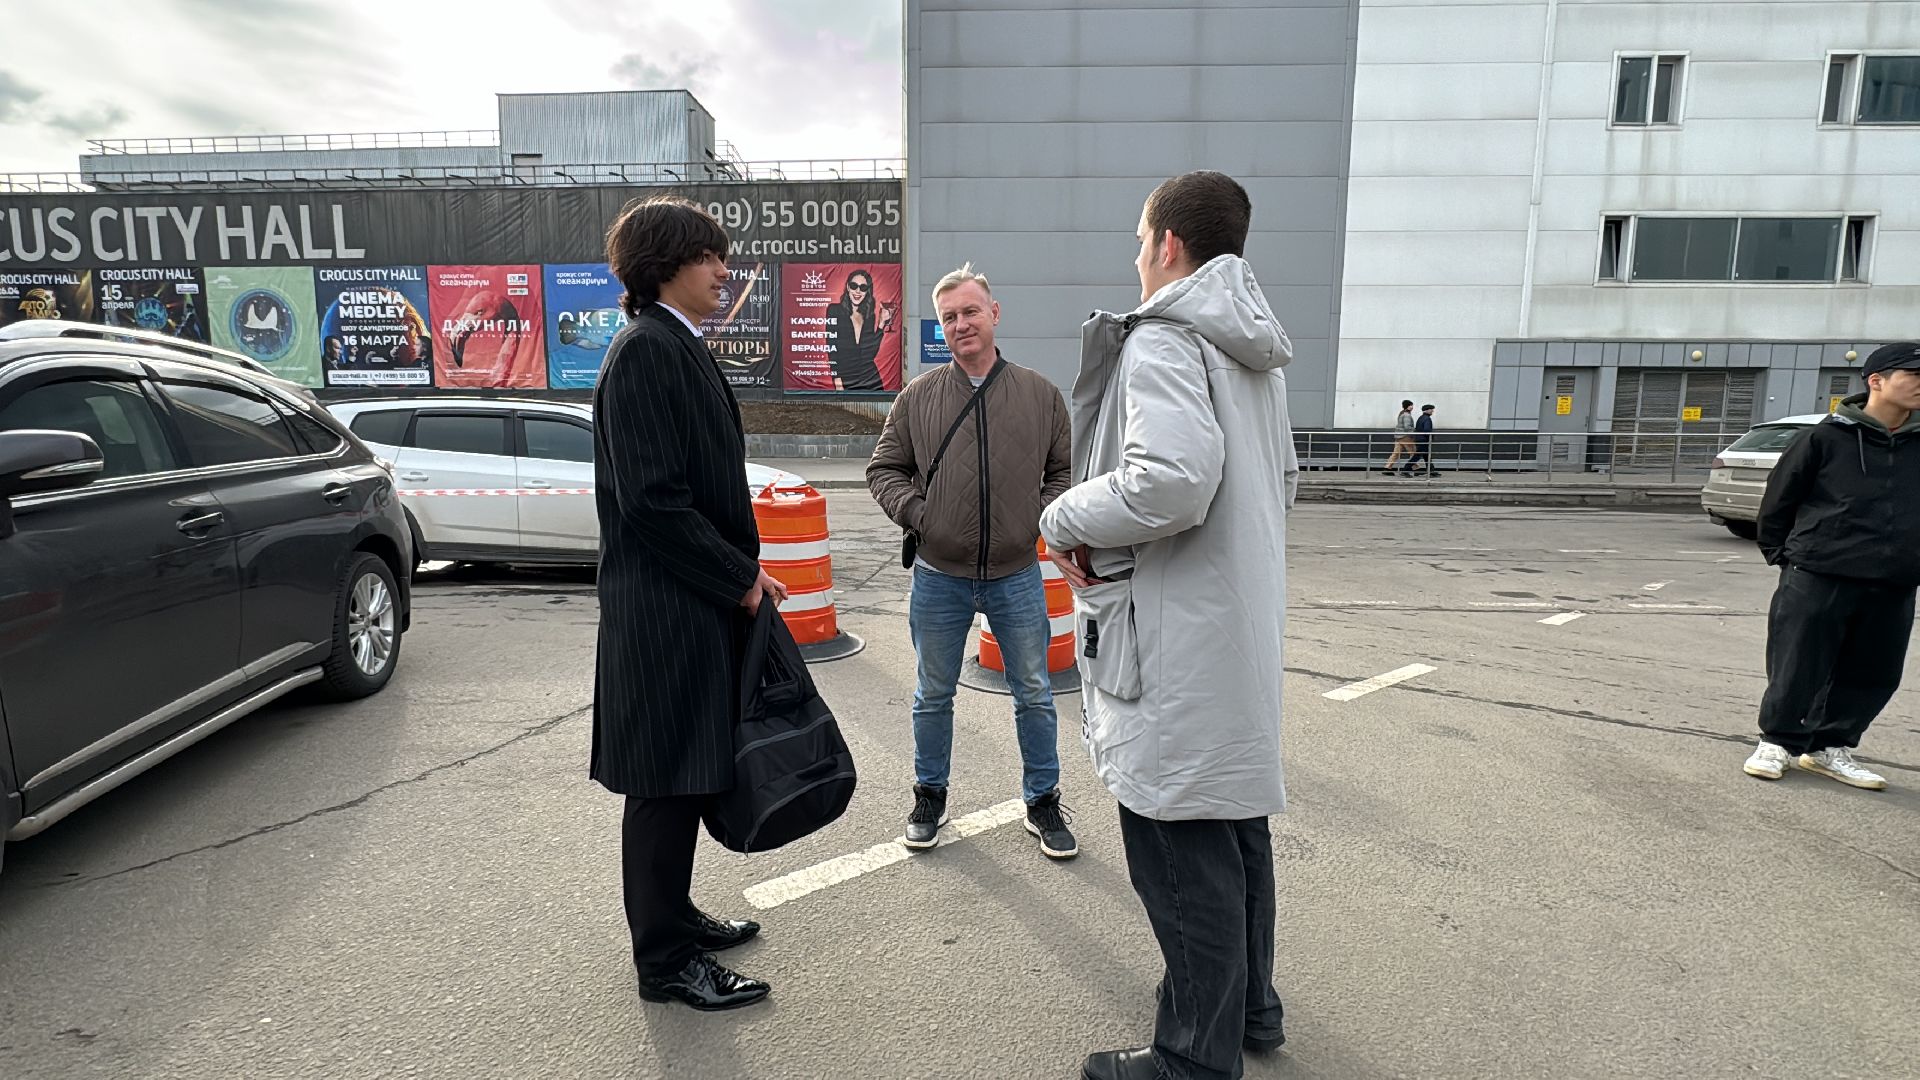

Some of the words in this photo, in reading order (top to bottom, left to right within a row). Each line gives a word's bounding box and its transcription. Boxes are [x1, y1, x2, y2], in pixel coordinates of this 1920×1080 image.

[707, 197, 753, 232] 99)
[761, 201, 795, 227] 55
[802, 200, 859, 227] 000
[866, 200, 900, 226] 55
[90, 206, 203, 261] CITY
[215, 204, 366, 260] HALL
[728, 234, 900, 255] w.crocus-hall.ru
[0, 274, 32, 285] ROCUS
[33, 274, 53, 285] CITY
[54, 273, 80, 285] HALL
[100, 269, 141, 281] CROCUS
[142, 269, 165, 280] CITY
[166, 268, 195, 280] HALL
[320, 269, 363, 281] CROCUS
[364, 269, 389, 280] CITY
[390, 269, 421, 280] HALL
[440, 279, 490, 288] океанариум
[557, 278, 608, 286] океанариум
[101, 285, 123, 300] 15
[338, 291, 406, 305] CINEMA
[749, 294, 770, 303] 18:00
[101, 301, 135, 310] апреля
[339, 305, 407, 319] MEDLEY
[558, 311, 629, 327] ОКЕА
[791, 317, 838, 325] КАРАОКЕ
[442, 319, 531, 333] ДЖУНГЛИ
[343, 335, 358, 346] 16
[361, 335, 409, 346] МАРТА
[791, 331, 838, 339] БАНКЕТЫ
[705, 340, 770, 355] РТЮРЫ
[791, 345, 838, 353] ВЕРАНДА
